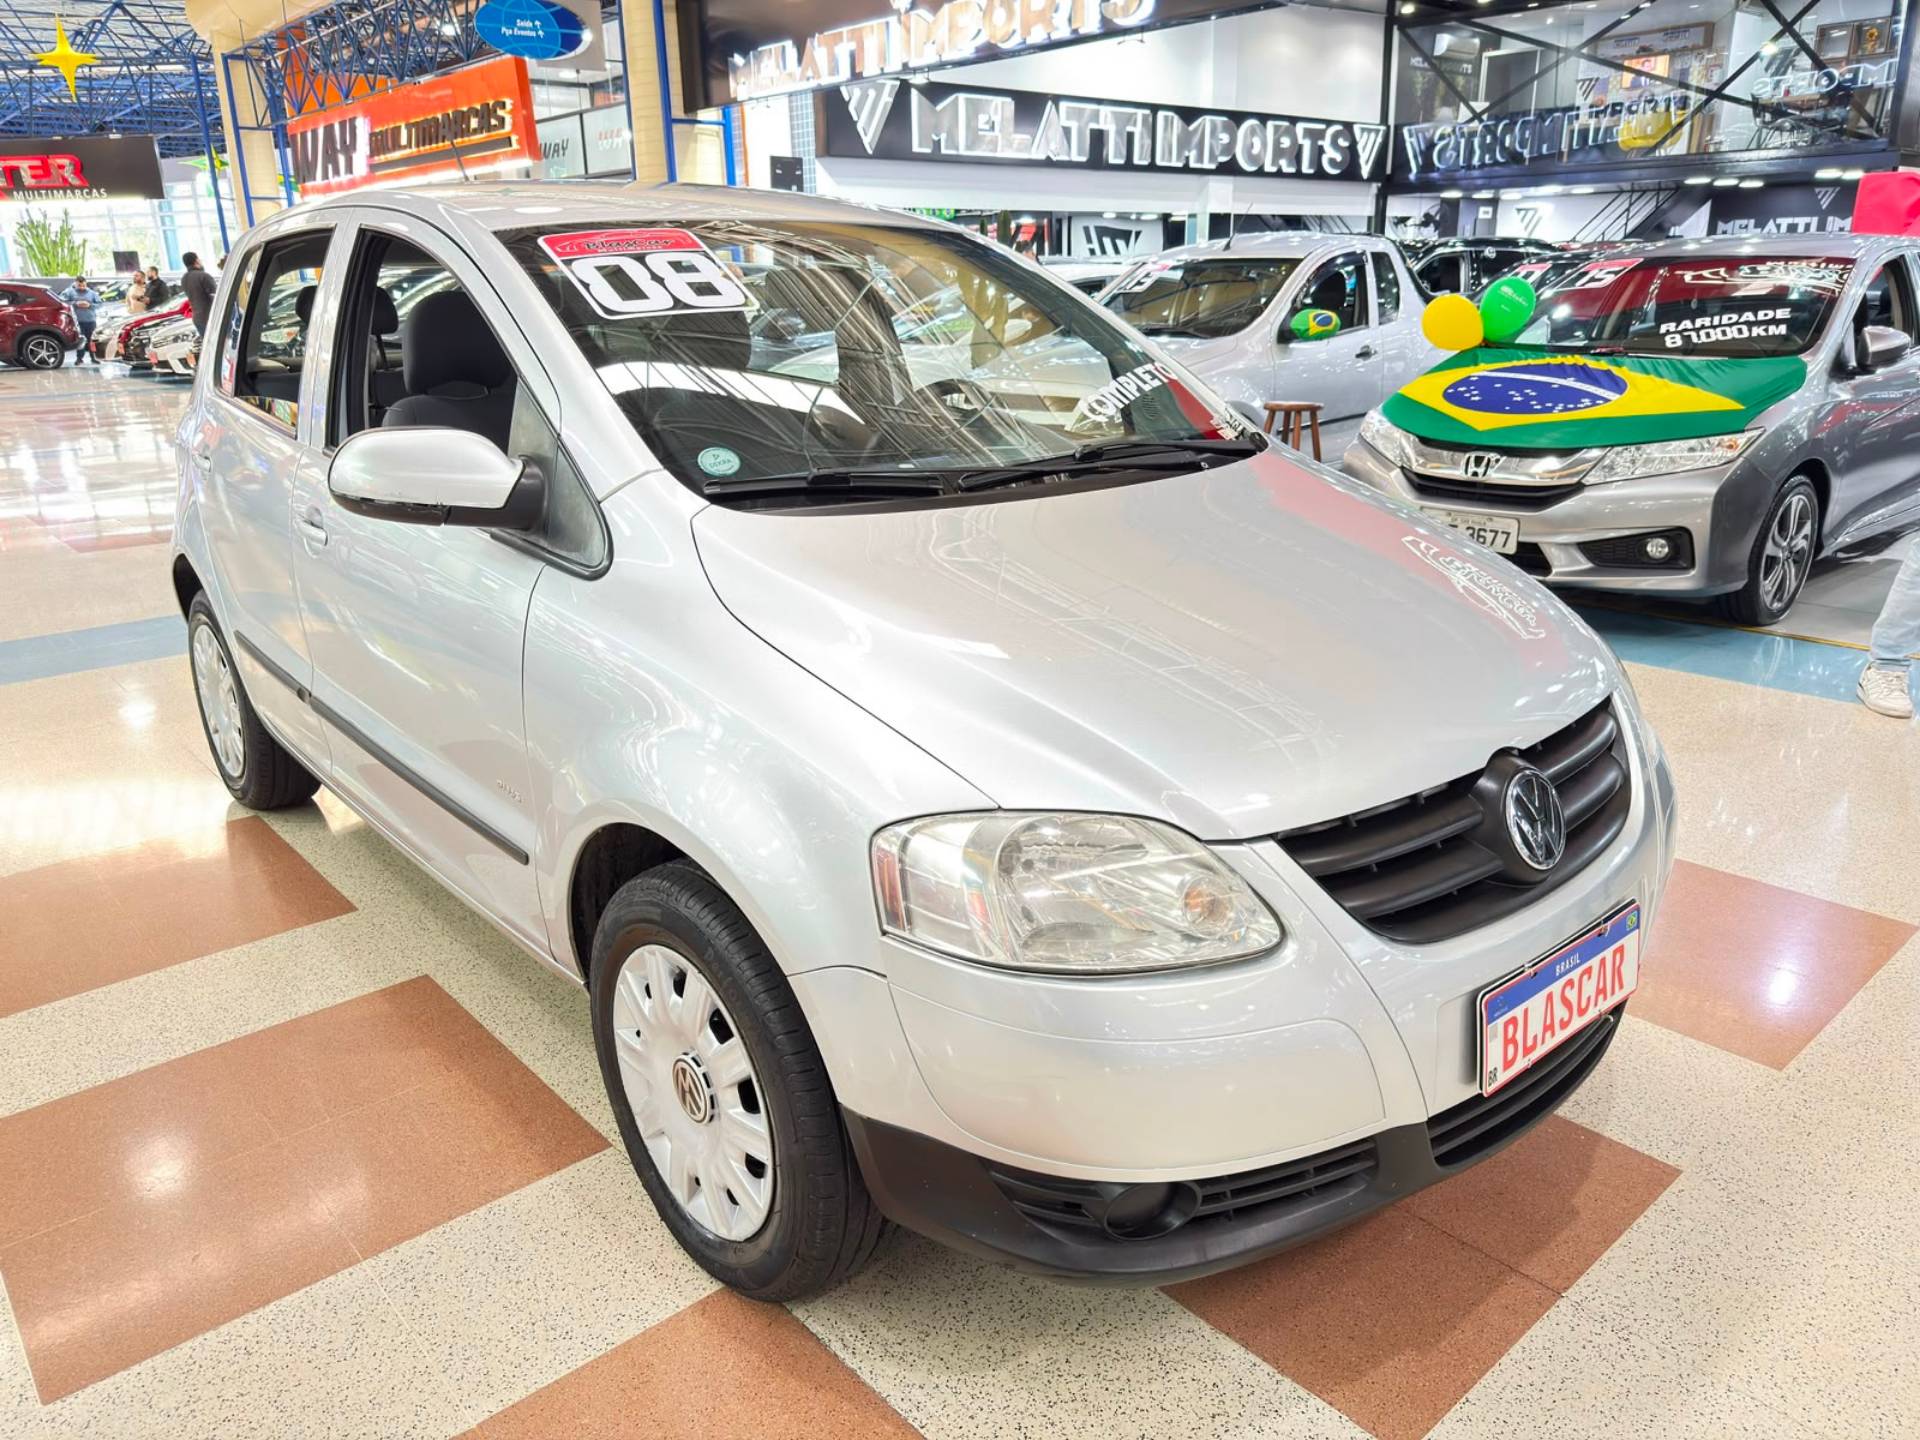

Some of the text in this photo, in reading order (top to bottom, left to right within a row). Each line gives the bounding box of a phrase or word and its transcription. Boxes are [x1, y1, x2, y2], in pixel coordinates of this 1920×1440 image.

[288, 116, 358, 184] WAY
[369, 100, 508, 158] MULTIMARCAS
[911, 88, 1350, 174] MELATTI IMPORTS
[13, 188, 108, 201] MULTIMARCAS
[1716, 216, 1819, 236] MELATTI
[571, 252, 746, 313] 08
[1659, 308, 1791, 334] RARIDADE
[1751, 324, 1787, 337] KM
[1080, 361, 1178, 423] COMPLETO
[1556, 952, 1581, 977] BRASIL
[1502, 943, 1625, 1073] BLASCAR
[1487, 1066, 1499, 1088] BR
